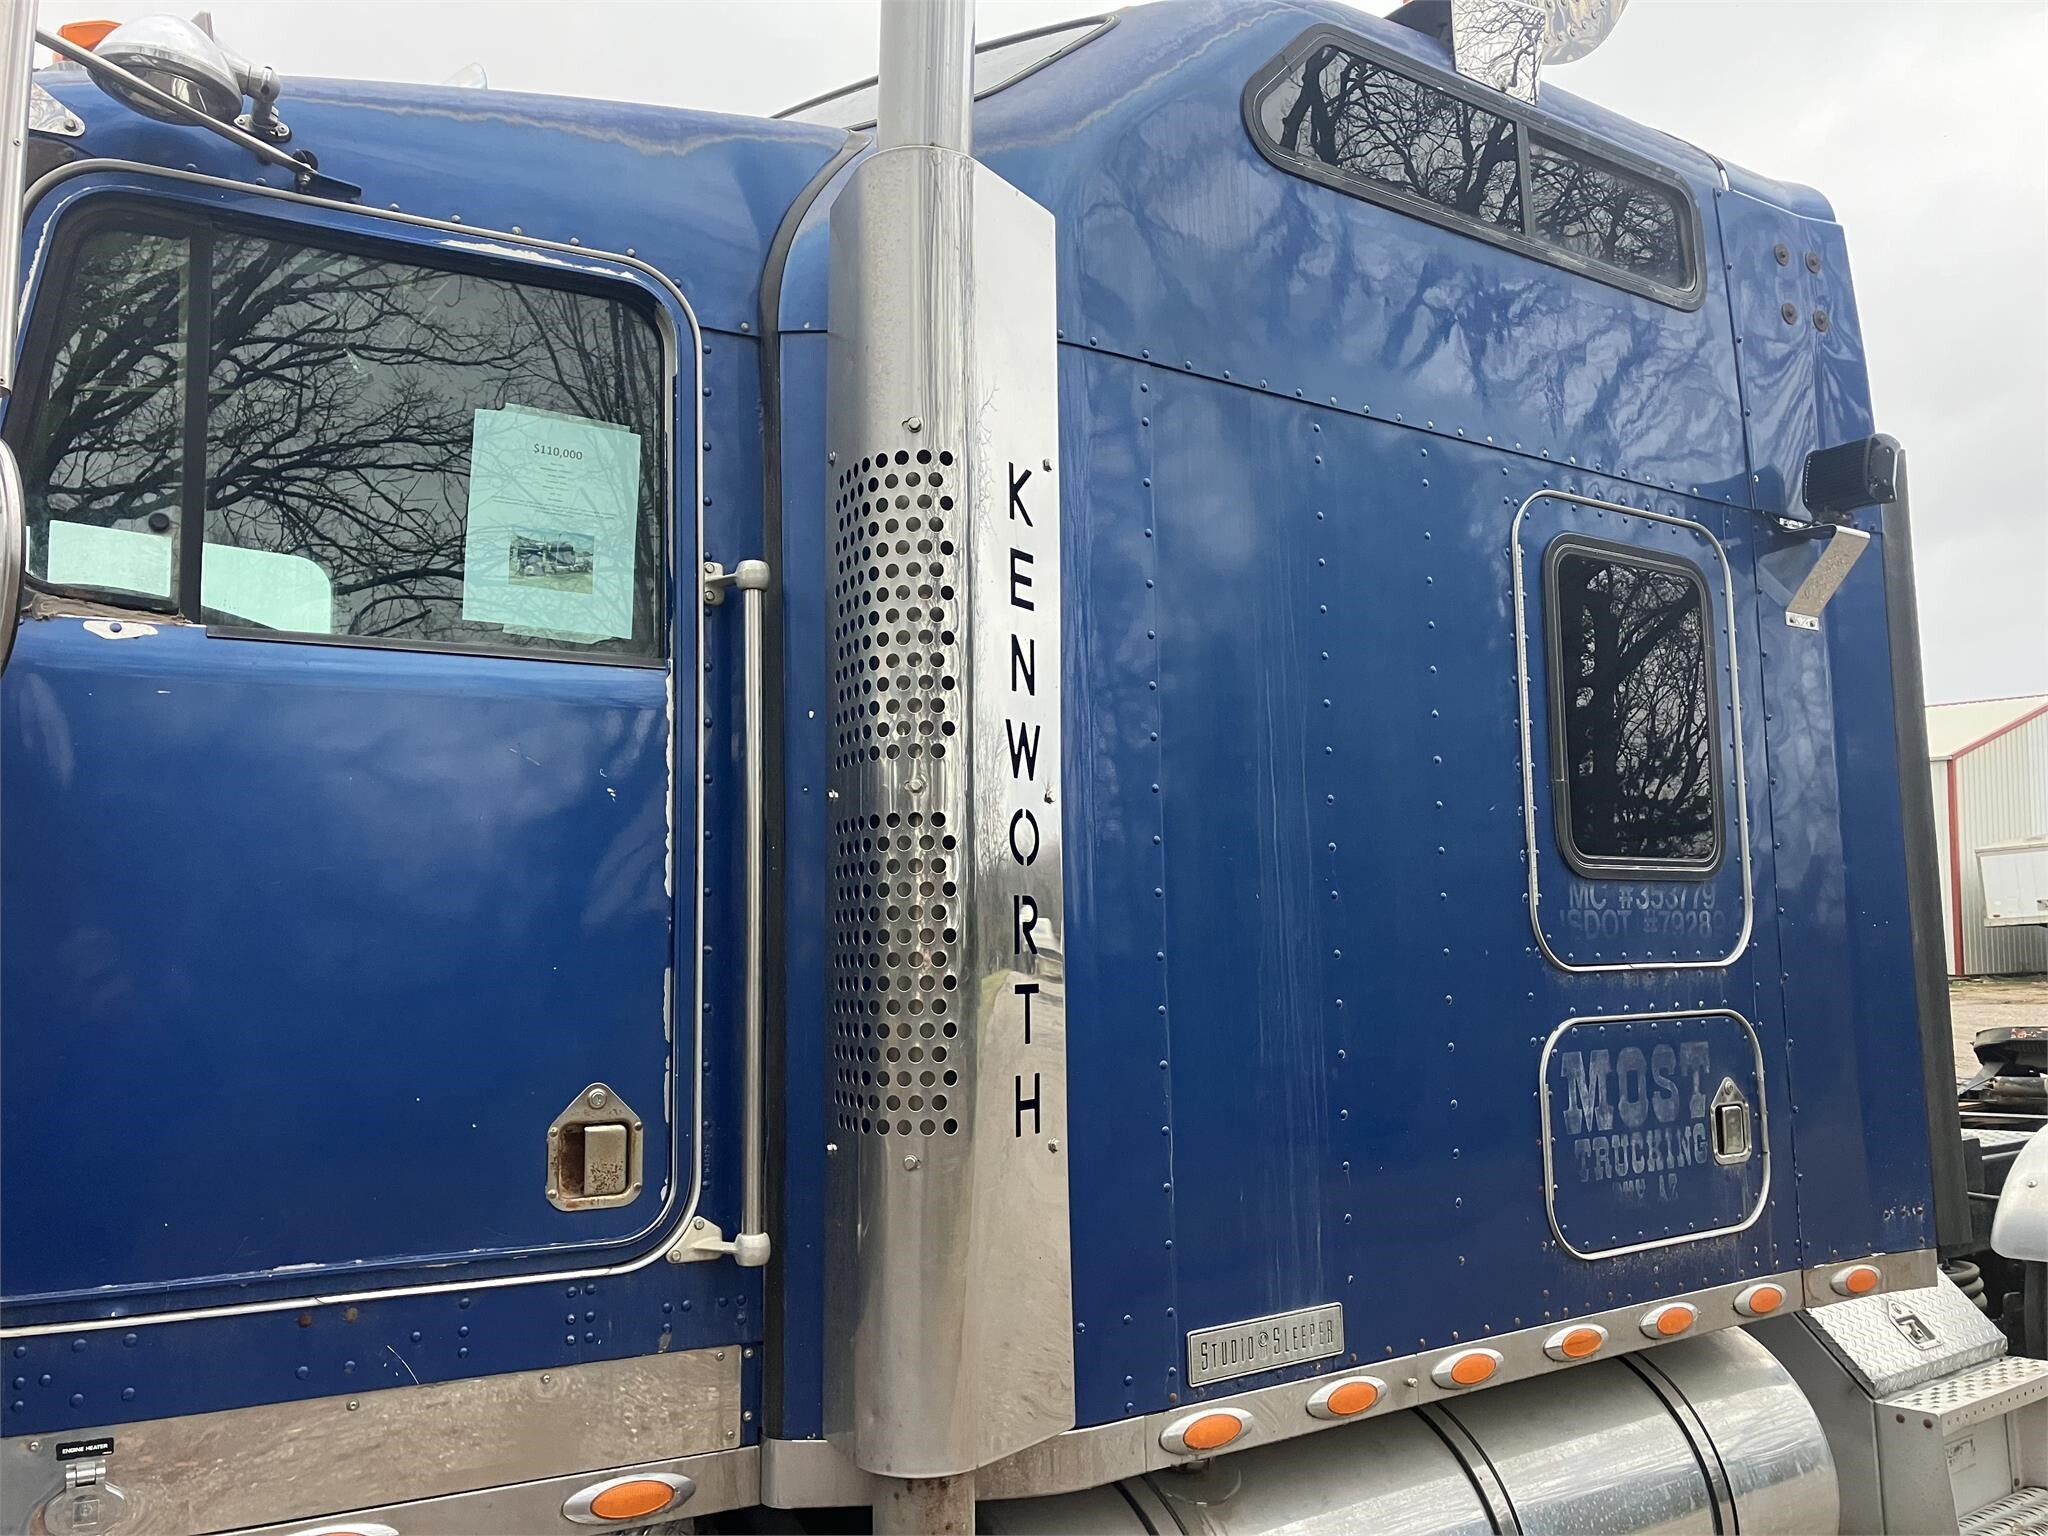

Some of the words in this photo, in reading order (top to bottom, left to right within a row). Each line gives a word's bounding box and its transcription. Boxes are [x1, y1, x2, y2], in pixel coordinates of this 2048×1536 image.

[533, 443, 583, 460] $110,000
[1005, 461, 1041, 1138] KENWORTH
[1569, 882, 1607, 910] MC
[1561, 1040, 1710, 1135] MOST
[1574, 1122, 1708, 1183] TRUCKING
[62, 1446, 84, 1455] ENGINE
[85, 1443, 108, 1451] HEATER
